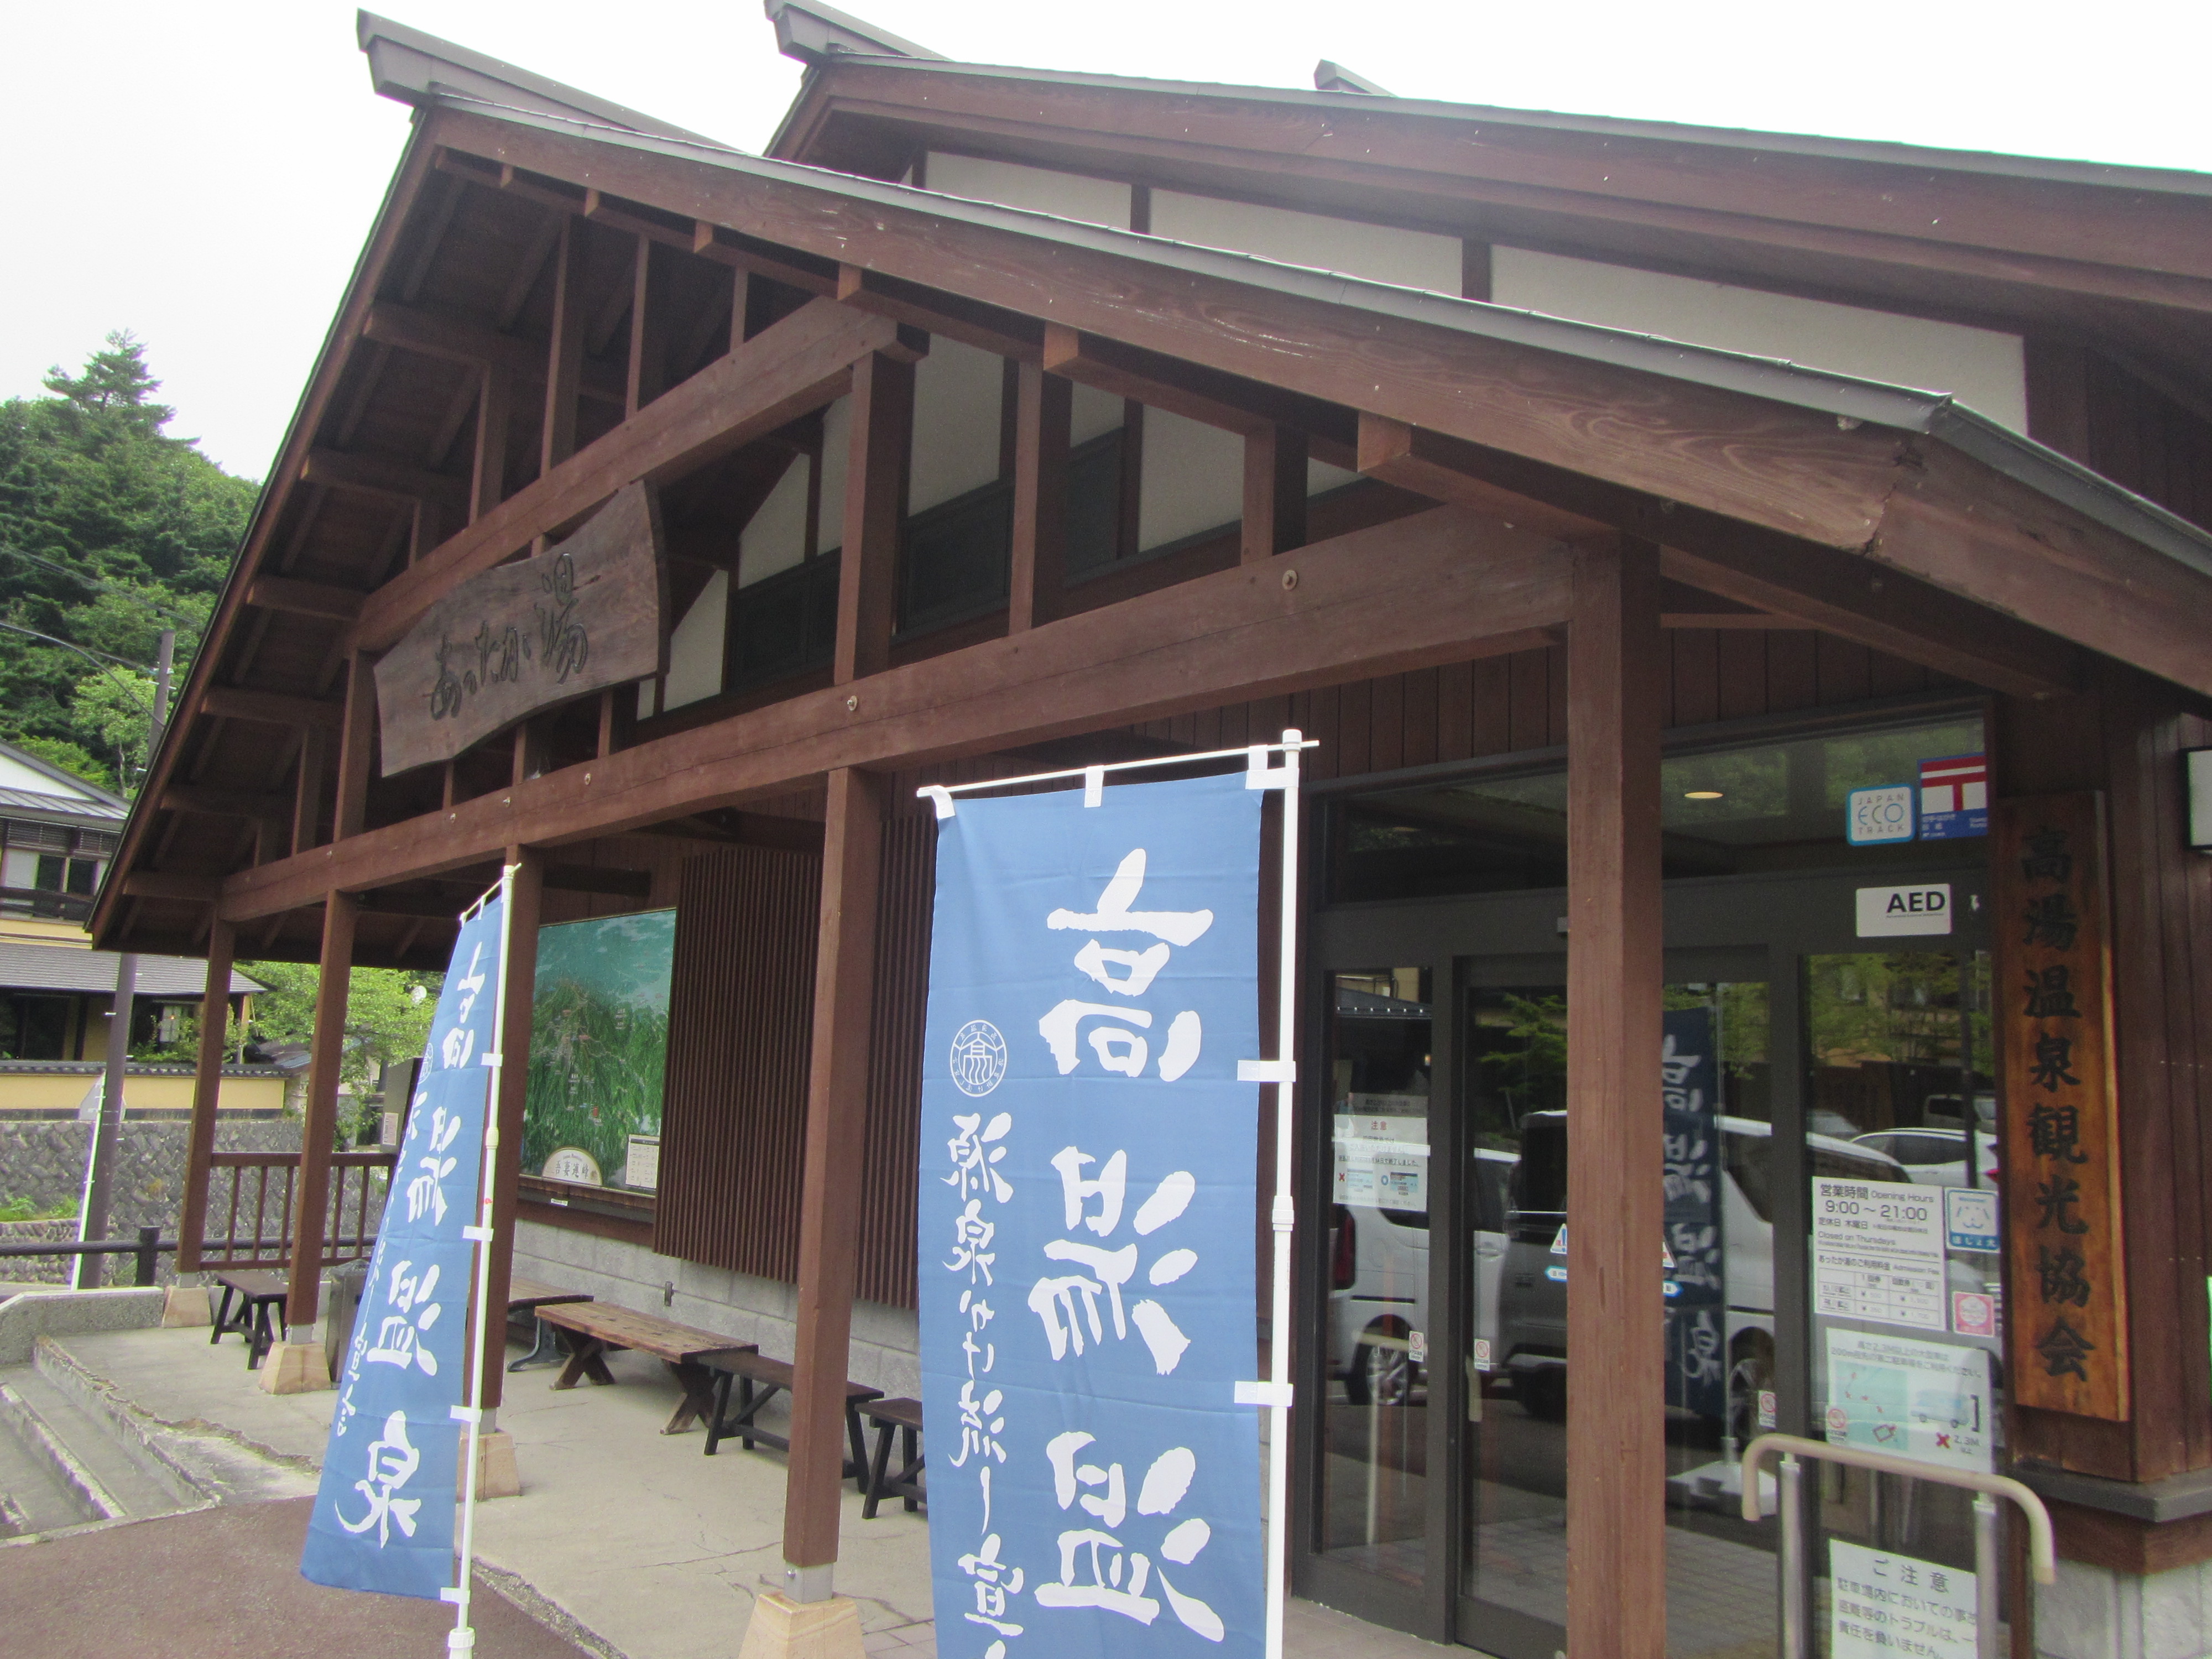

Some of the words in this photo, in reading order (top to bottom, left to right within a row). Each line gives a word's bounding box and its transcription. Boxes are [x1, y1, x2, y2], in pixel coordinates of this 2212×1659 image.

[1858, 793, 1904, 805] JAPAN
[1858, 803, 1904, 826] ECO
[1858, 825, 1903, 835] TRACK
[1886, 891, 1946, 913] AED
[2021, 824, 2095, 1382] 高湯温泉観光協会
[1371, 1120, 1388, 1130] 注意
[1820, 1183, 1869, 1199] 営業時間
[1871, 1190, 1905, 1202] Opening
[1908, 1193, 1934, 1203] Hours
[1825, 1199, 1859, 1214] 9:00
[1881, 1204, 1927, 1220] 21:00
[1818, 1217, 1841, 1227] 定休日
[1845, 1219, 1868, 1229] 木曜日
[1818, 1230, 1843, 1240] Closed
[1856, 1234, 1896, 1245] Thursdays
[1954, 1434, 1980, 1447] 2.3M
[1874, 1558, 1949, 1593] ご注意
